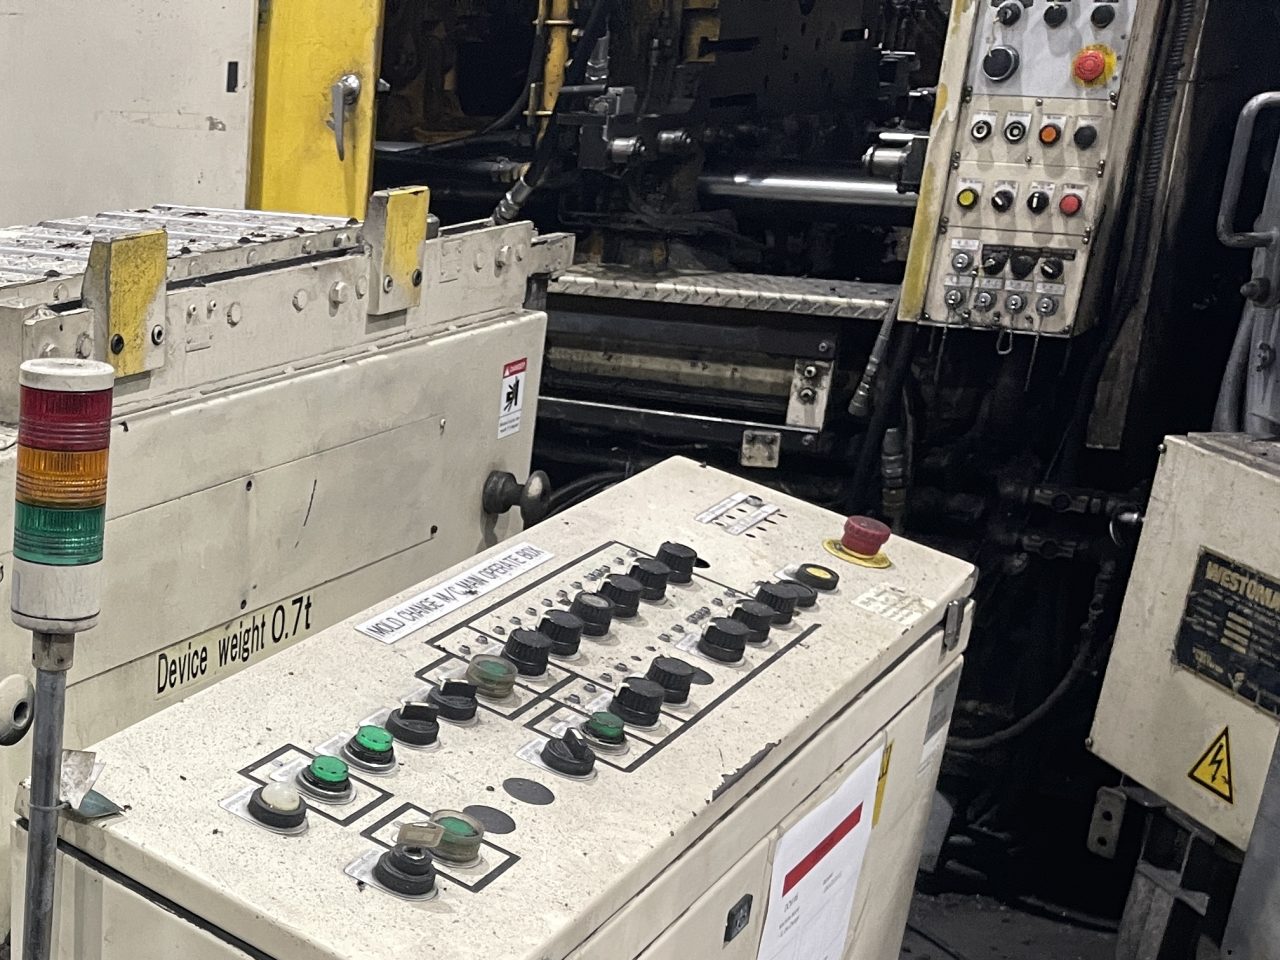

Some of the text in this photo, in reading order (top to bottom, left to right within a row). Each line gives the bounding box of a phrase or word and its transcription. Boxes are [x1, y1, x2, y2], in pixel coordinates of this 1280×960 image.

[366, 616, 405, 638] MOLD
[397, 597, 444, 623] CHANGE
[478, 555, 525, 580] OPERATE
[516, 545, 544, 564] BOX
[157, 595, 312, 694] Device weight 0.7t
